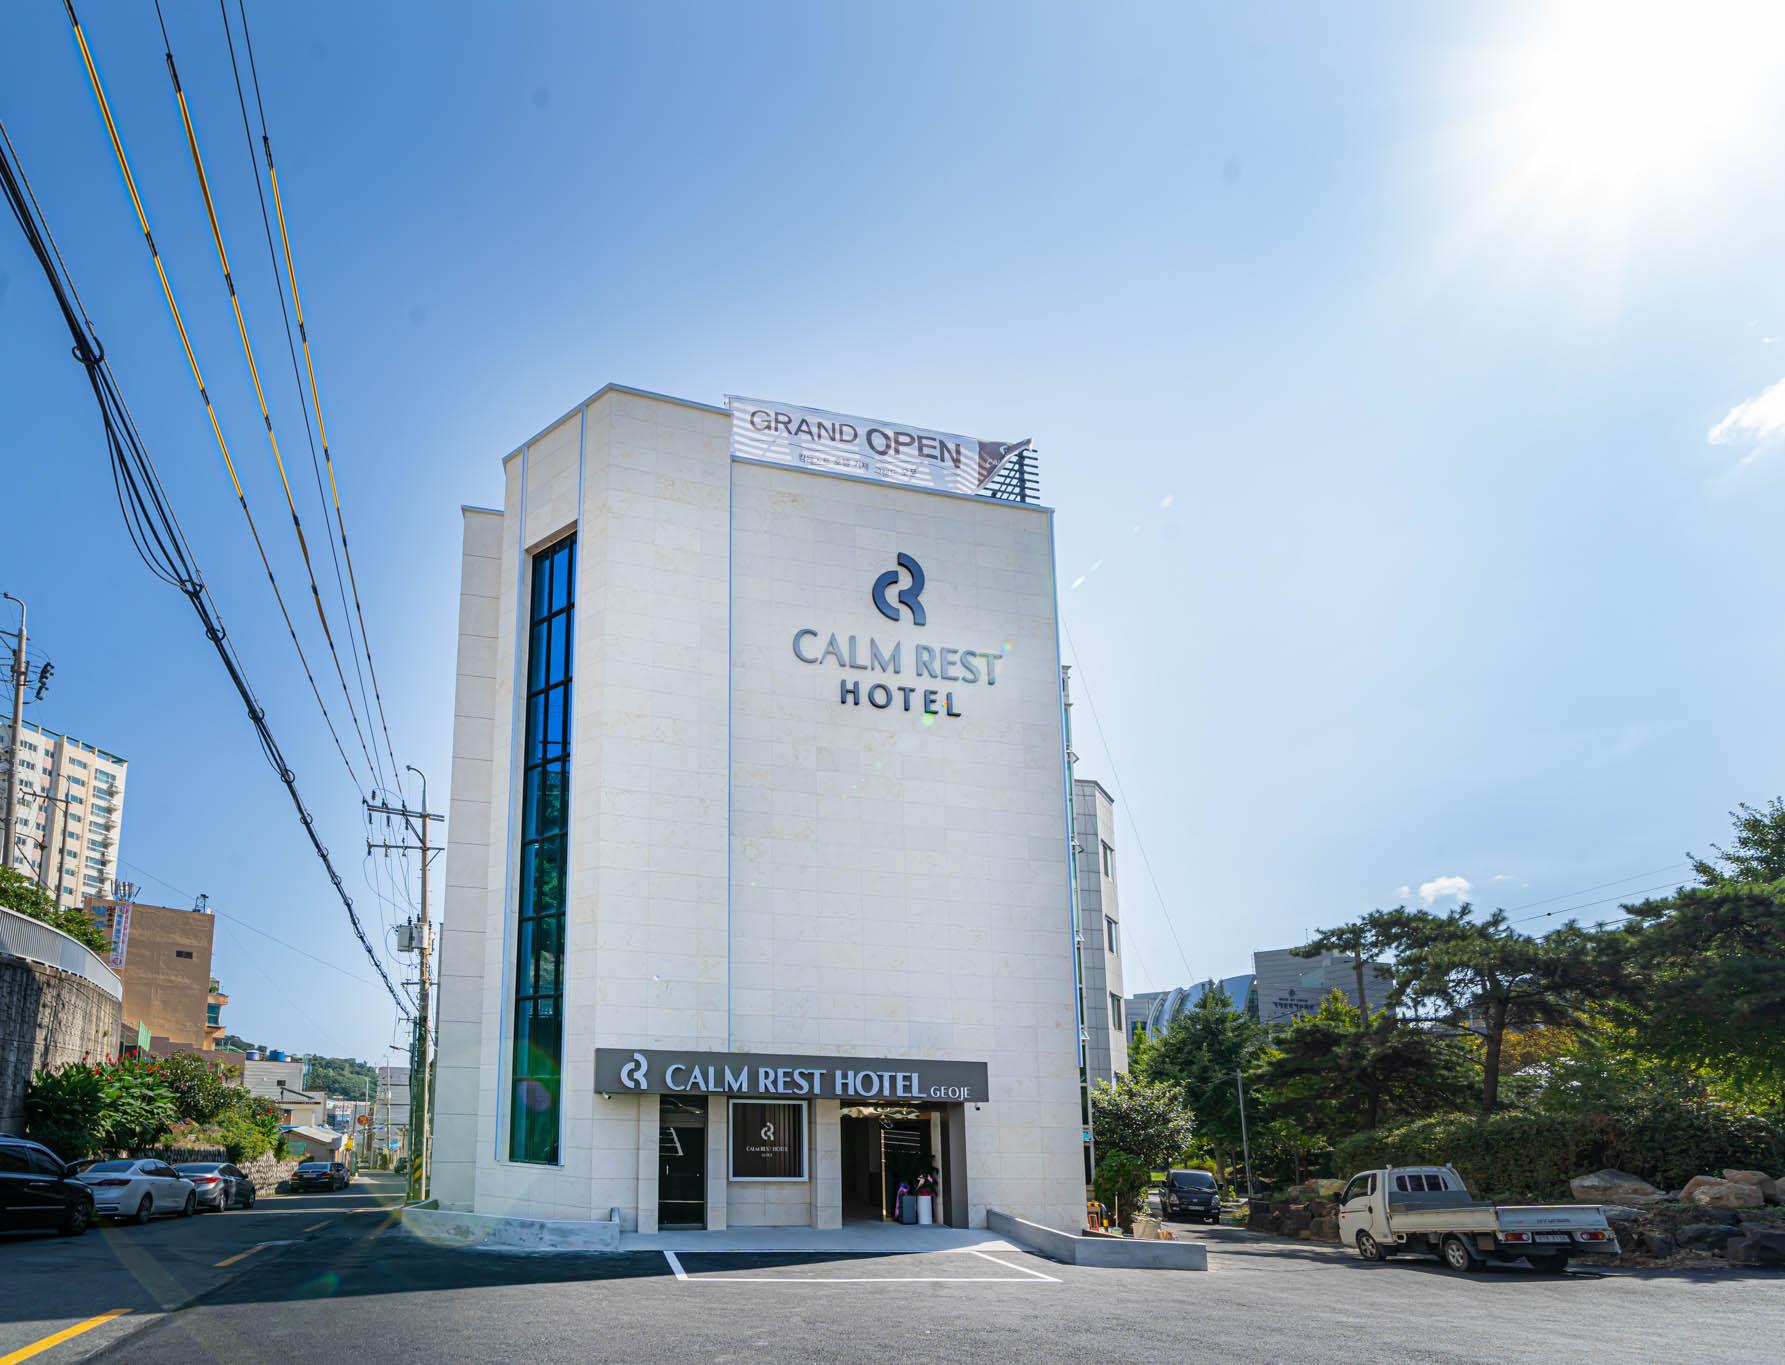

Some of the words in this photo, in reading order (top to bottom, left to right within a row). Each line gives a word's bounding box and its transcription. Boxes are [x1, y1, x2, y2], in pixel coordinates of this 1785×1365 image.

[750, 409, 858, 443] GRAND
[866, 428, 961, 468] OPEN
[793, 628, 901, 674] CALM
[915, 643, 1003, 686] REST
[840, 679, 961, 717] HOTEL
[665, 1064, 748, 1093] CALM
[758, 1067, 827, 1095] REST
[836, 1069, 927, 1097] HOTEL
[930, 1086, 971, 1099] GEOJE
